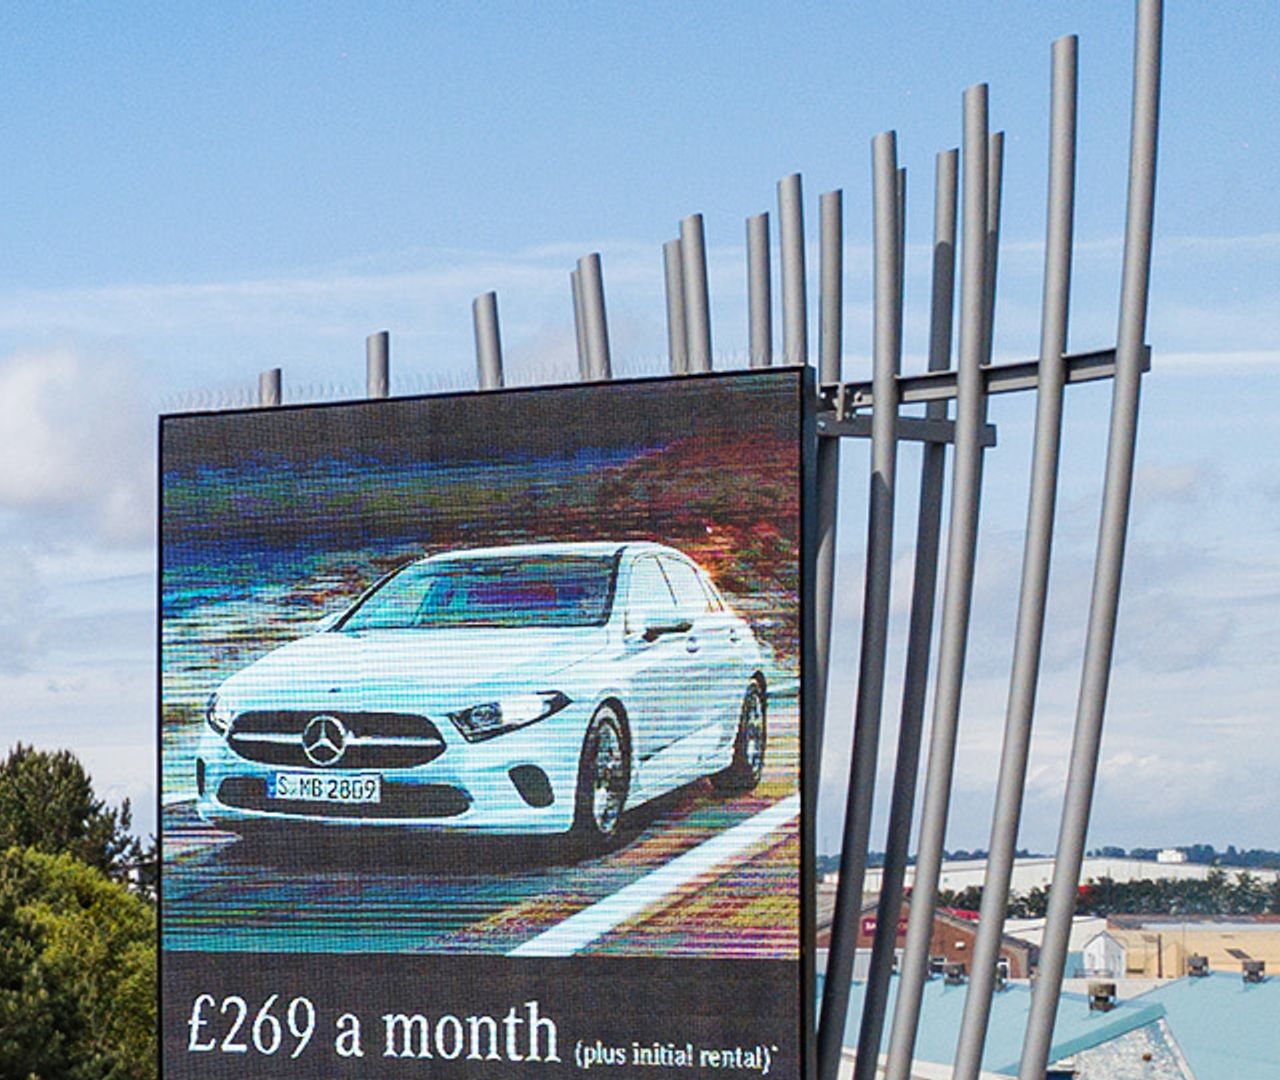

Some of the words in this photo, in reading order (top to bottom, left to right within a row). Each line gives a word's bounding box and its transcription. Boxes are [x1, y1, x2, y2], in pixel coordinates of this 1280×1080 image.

[188, 995, 315, 1058] £269
[336, 1014, 363, 1056] a
[382, 1001, 561, 1062] month
[575, 1041, 625, 1068] (plus
[633, 1043, 692, 1066] initial
